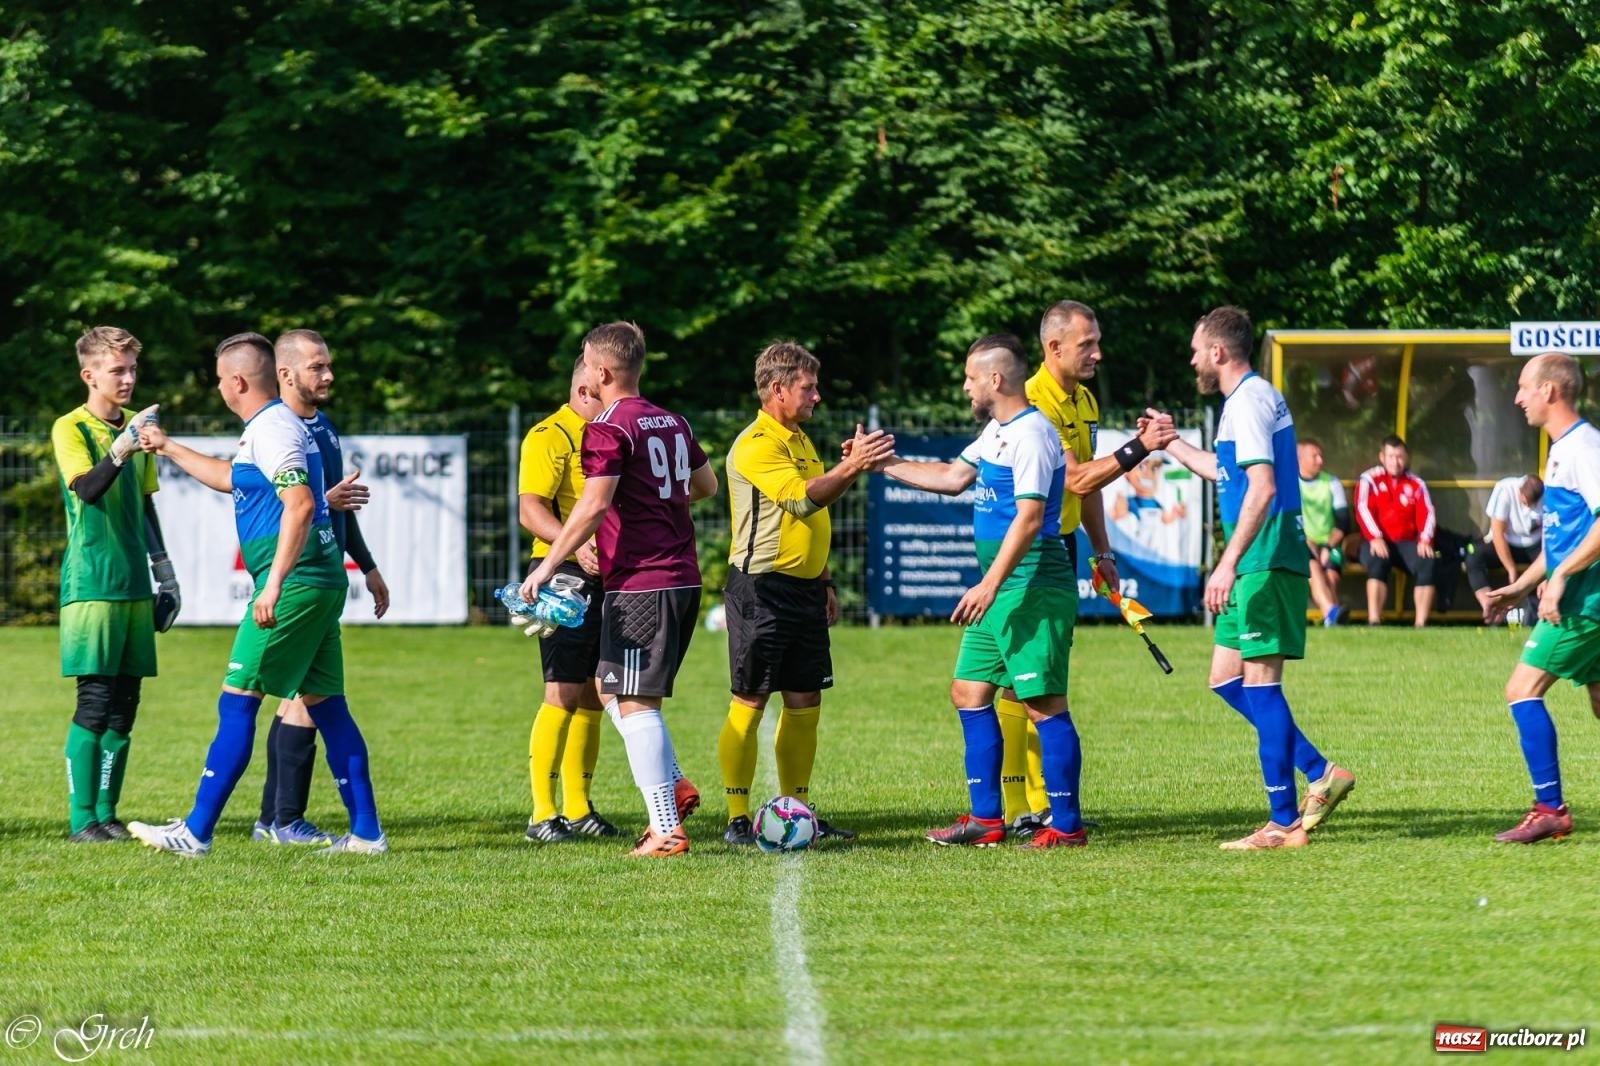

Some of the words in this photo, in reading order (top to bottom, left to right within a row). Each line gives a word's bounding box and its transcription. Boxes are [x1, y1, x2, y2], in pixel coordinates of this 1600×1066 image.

[637, 415, 678, 430] GRUCHA
[375, 451, 454, 477] OCICE
[647, 433, 691, 499] 94
